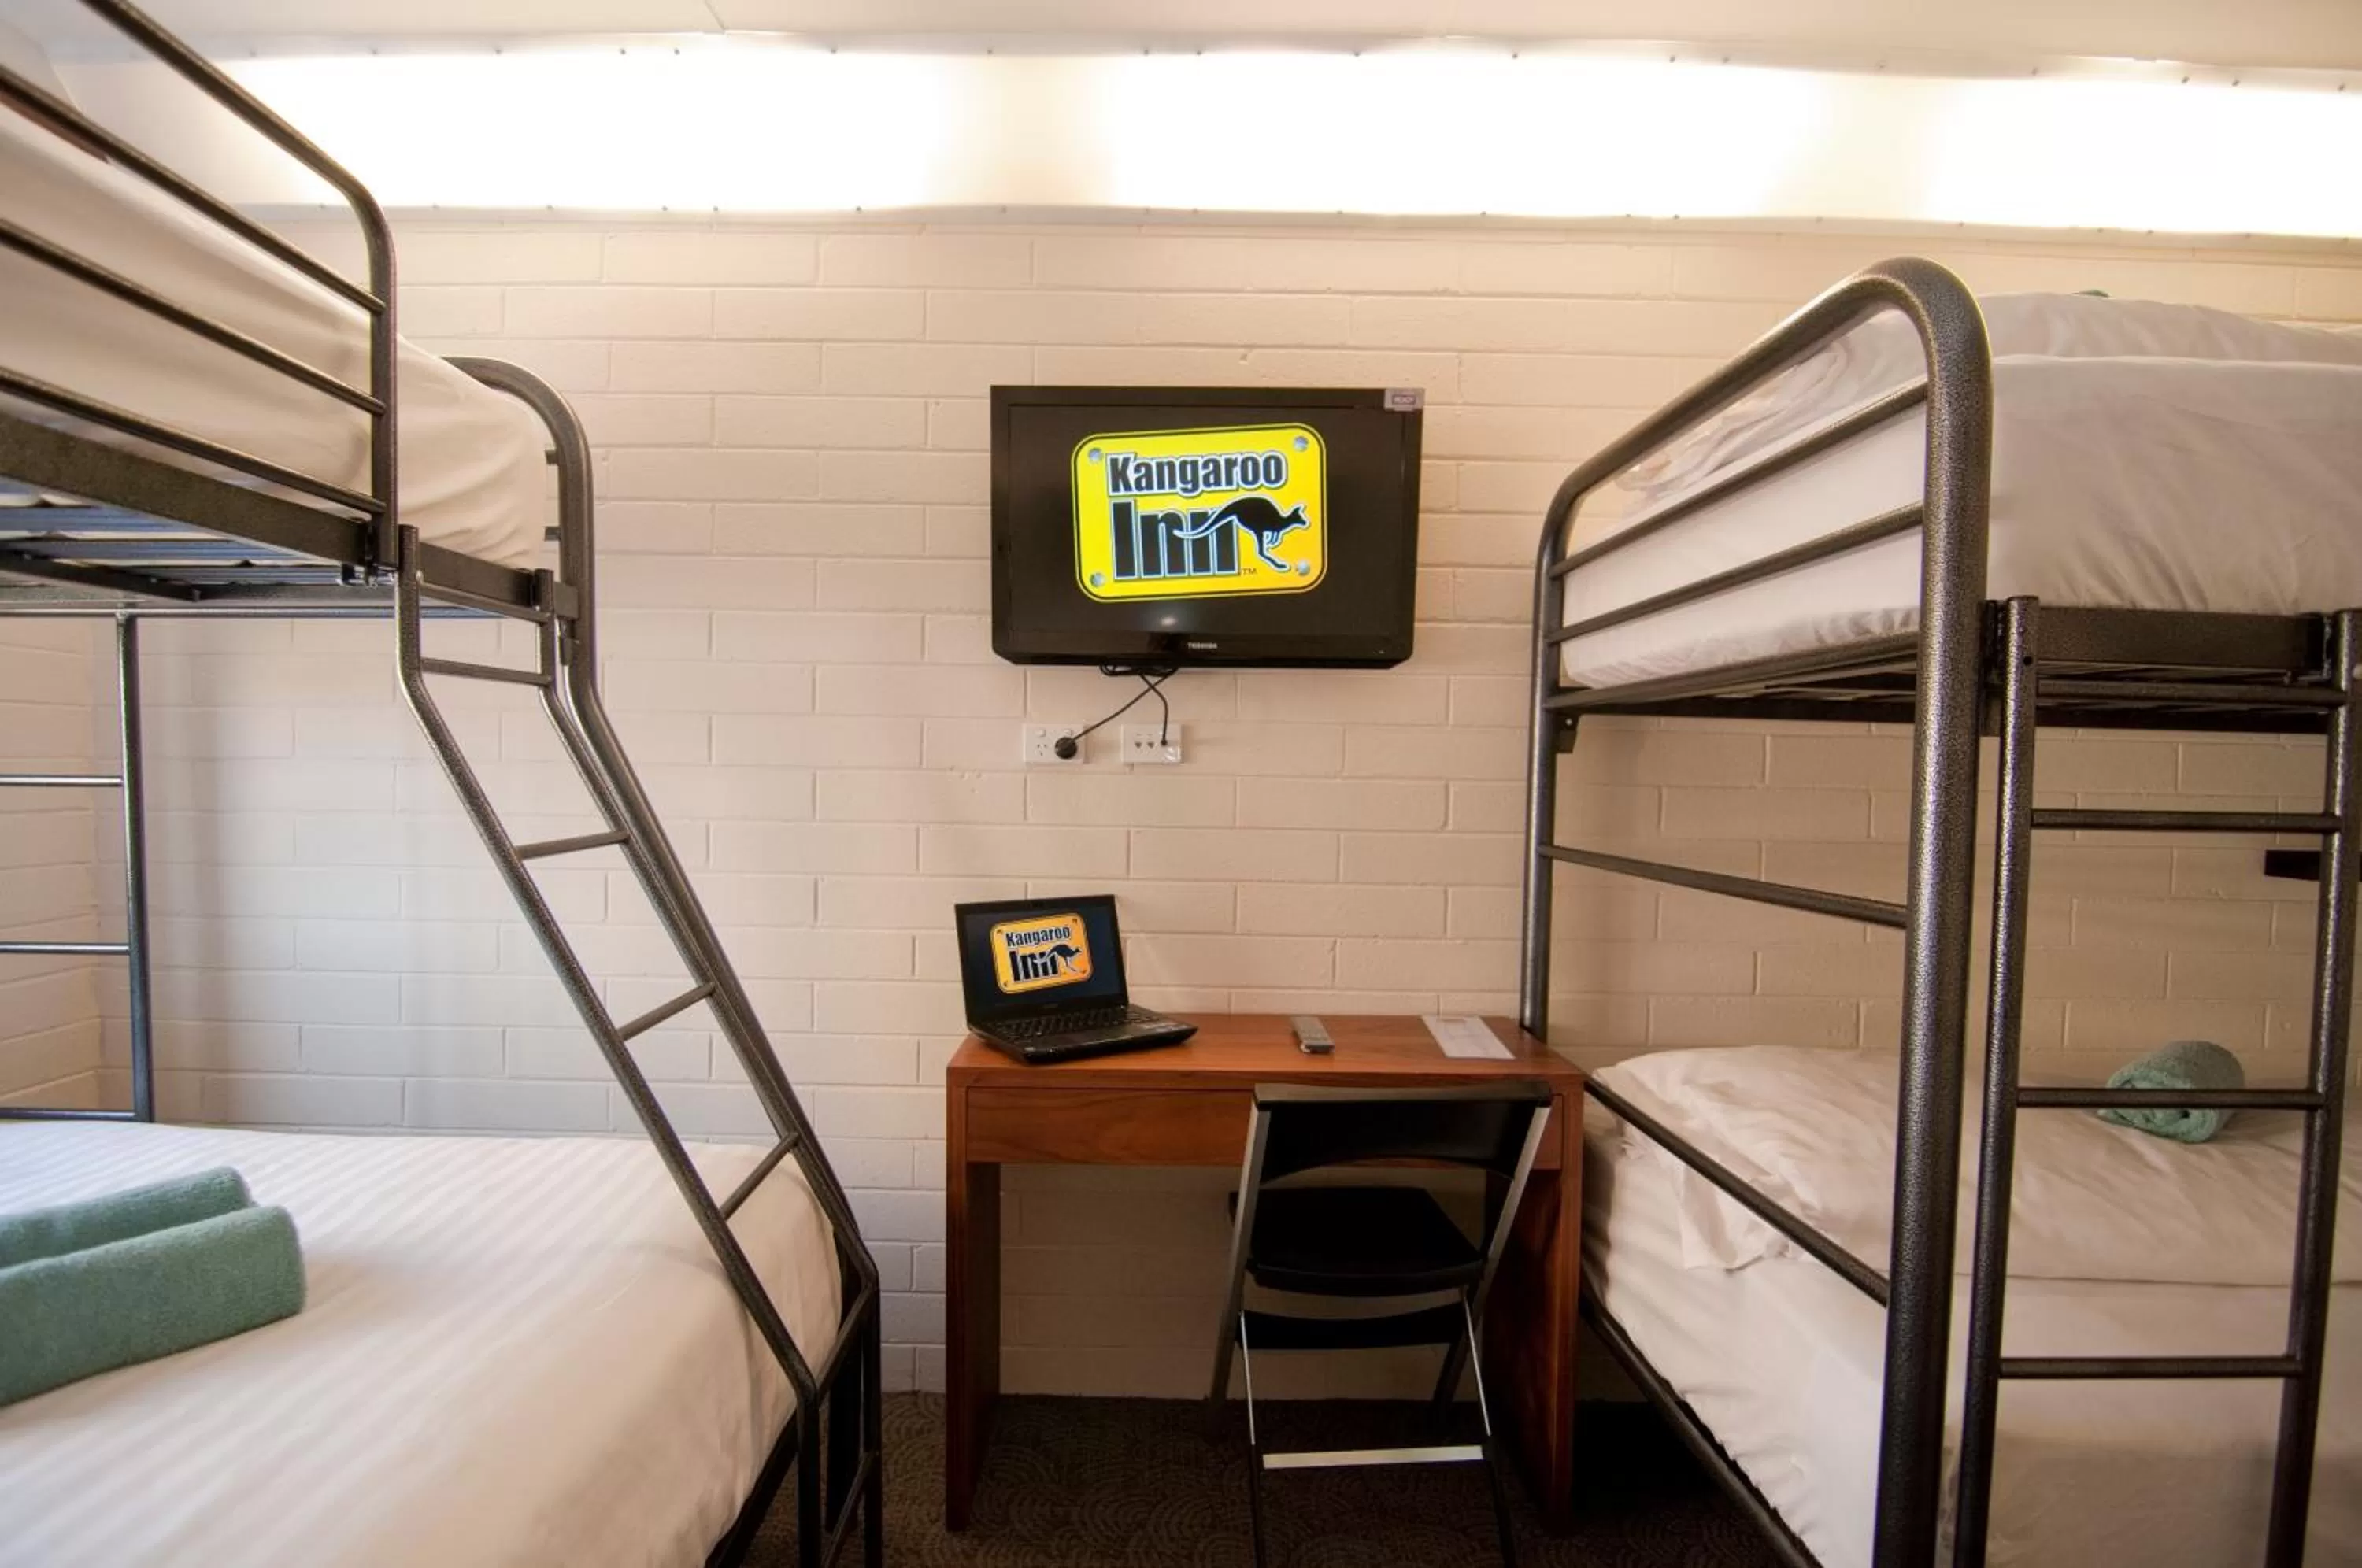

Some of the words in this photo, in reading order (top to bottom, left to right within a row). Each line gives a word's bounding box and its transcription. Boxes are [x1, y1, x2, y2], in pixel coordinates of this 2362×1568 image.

[1108, 452, 1287, 497] Kangaroo
[1111, 500, 1240, 581] Inn
[1005, 926, 1071, 947] Kangaroo
[1009, 950, 1059, 982] Inn
